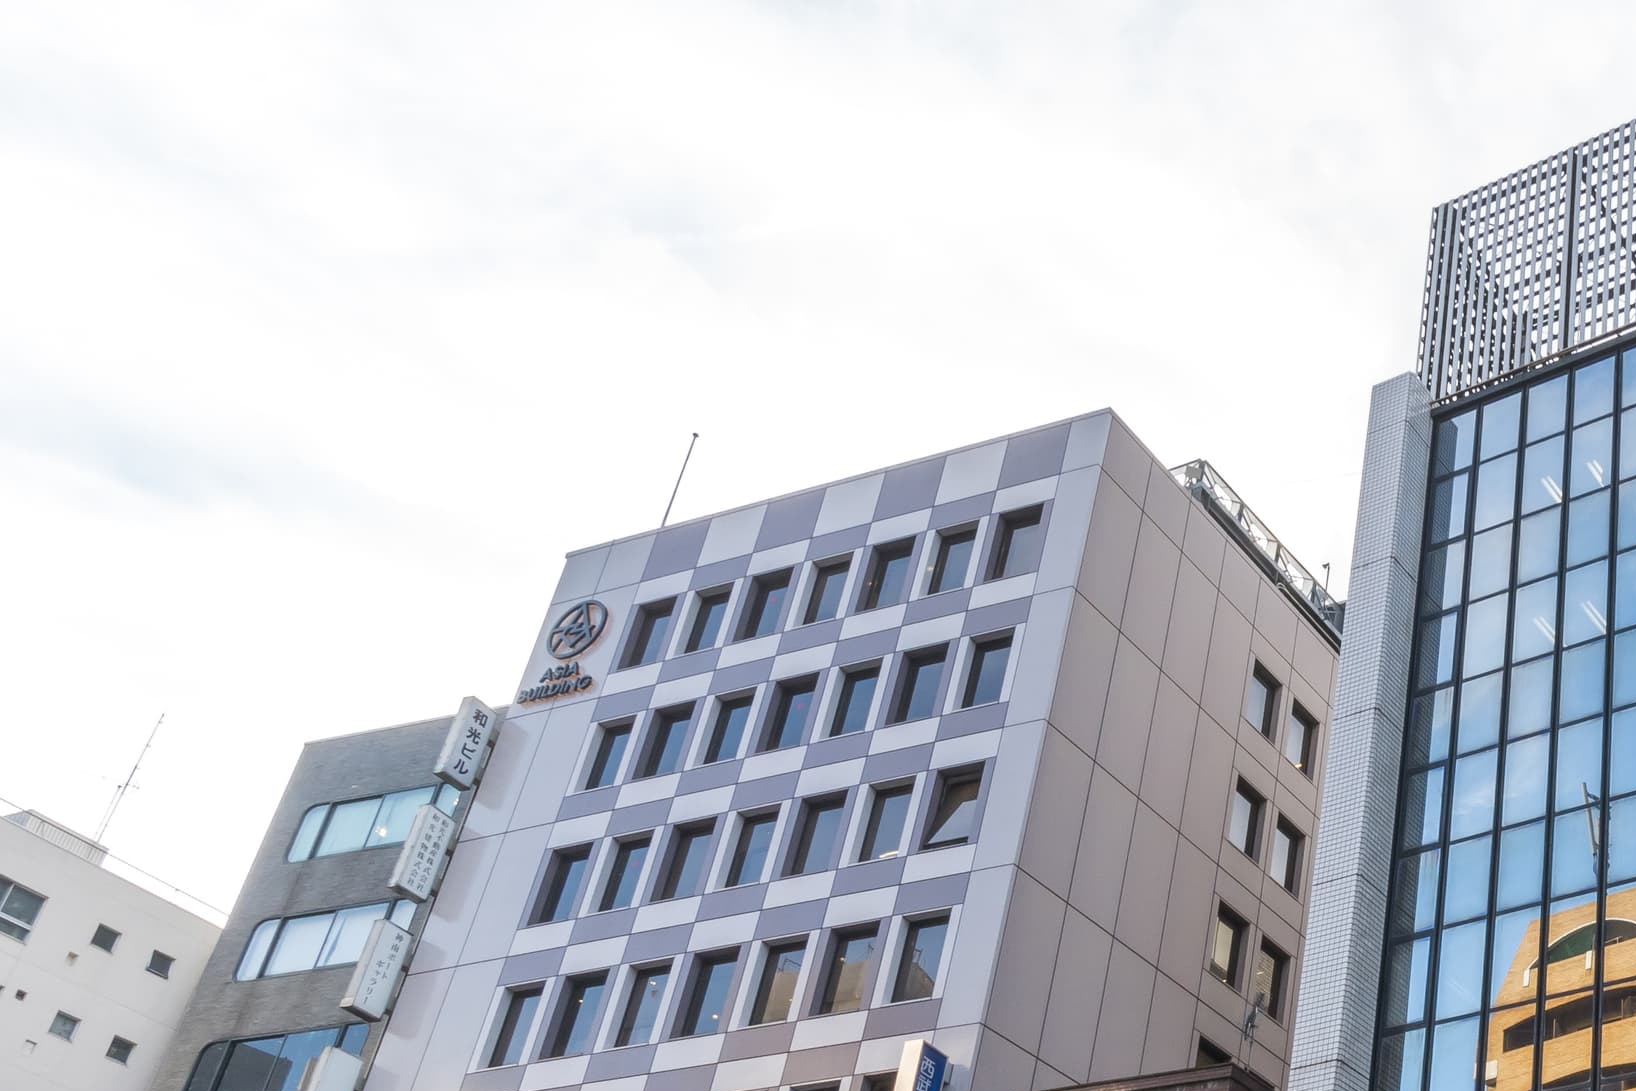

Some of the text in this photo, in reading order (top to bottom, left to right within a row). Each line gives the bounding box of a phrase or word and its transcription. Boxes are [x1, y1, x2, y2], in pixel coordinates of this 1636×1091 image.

[539, 661, 580, 683] ASIA
[516, 675, 593, 704] BUILDING
[453, 708, 489, 775] 和光ビル
